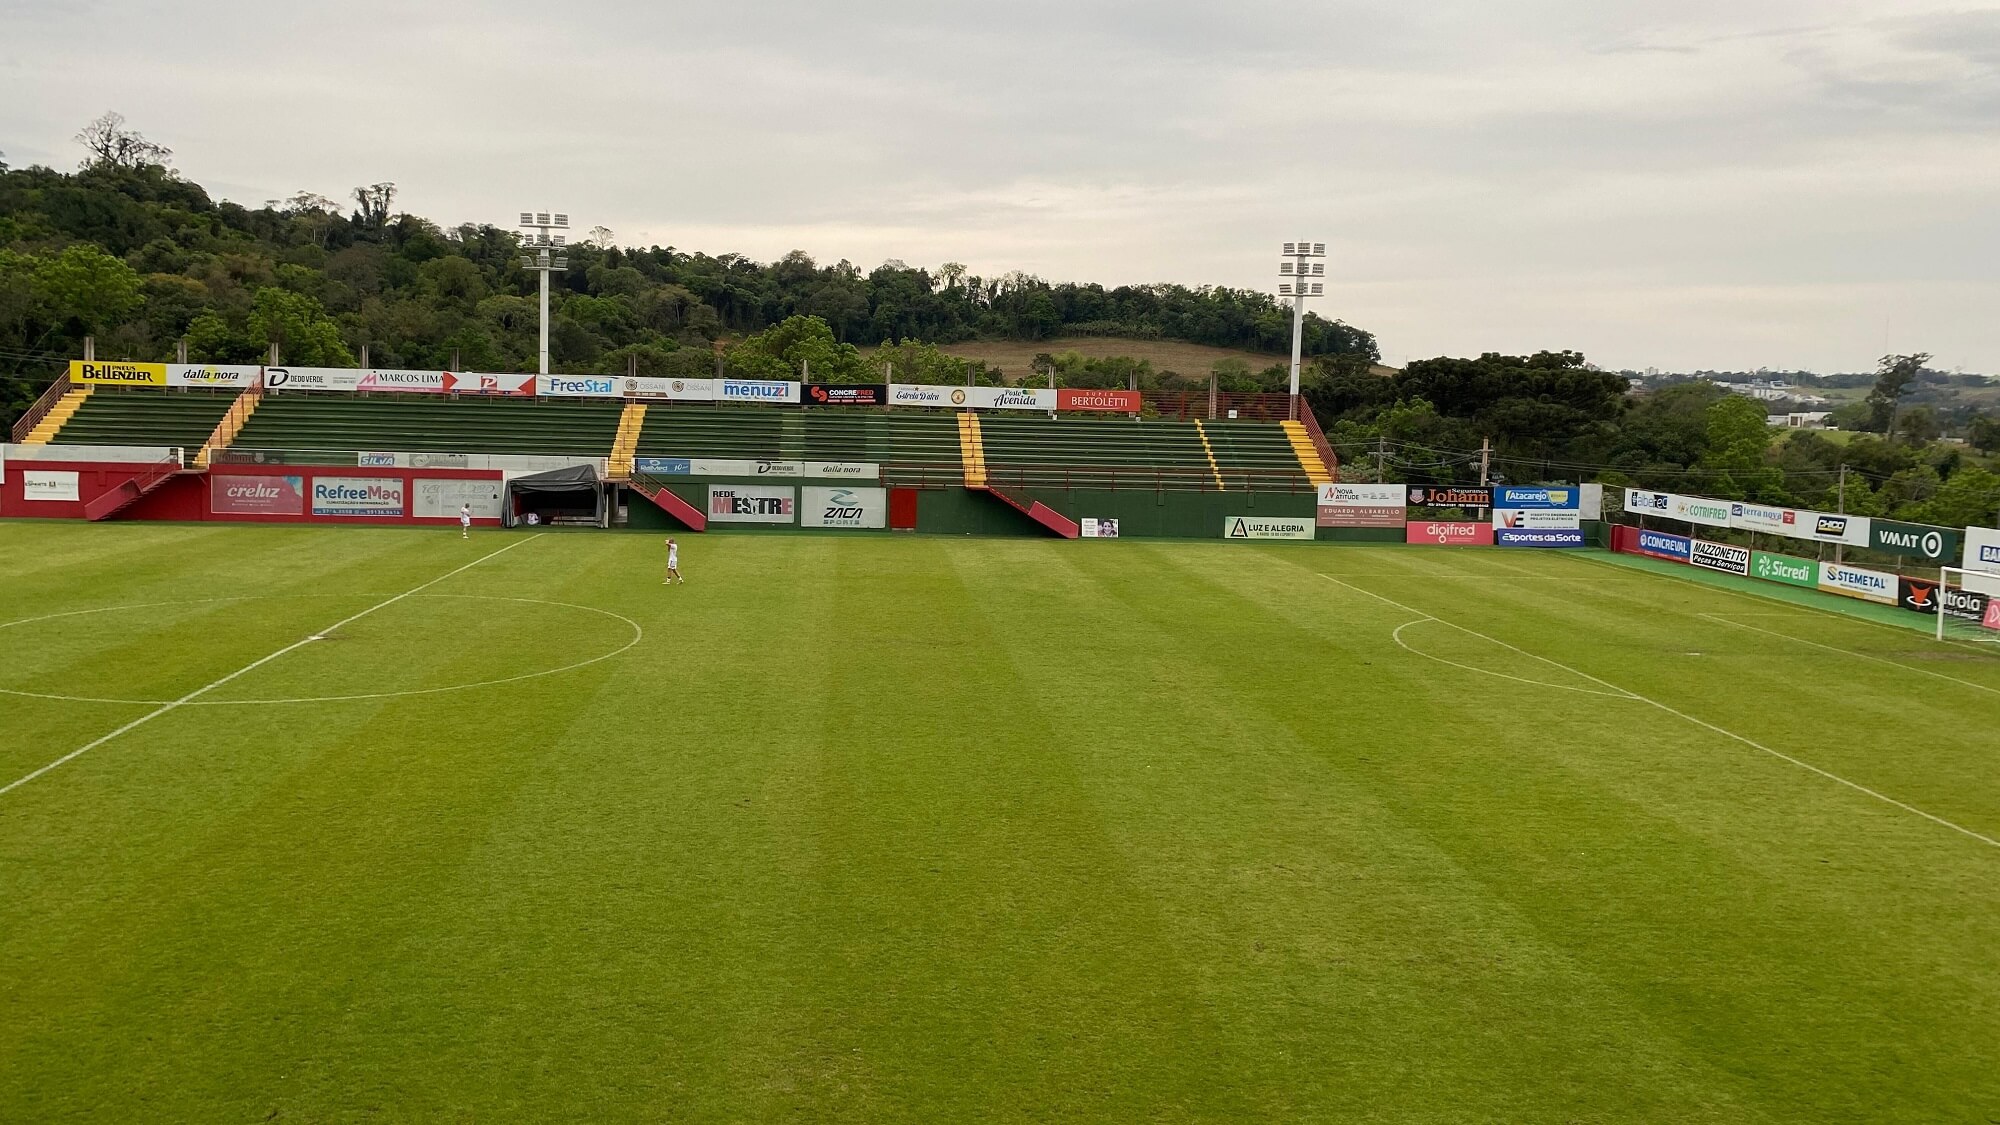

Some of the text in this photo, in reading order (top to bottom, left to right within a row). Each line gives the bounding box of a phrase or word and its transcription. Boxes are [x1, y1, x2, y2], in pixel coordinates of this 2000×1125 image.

[183, 369, 210, 379] dalla
[213, 371, 239, 380] nora
[305, 375, 323, 383] VERDE
[379, 373, 444, 383] MARCOS LIMA
[551, 379, 612, 393] FreeStal
[724, 383, 789, 397] menuzzi
[993, 394, 1037, 407] Avenida
[1071, 396, 1128, 407] BERTOLETTI
[361, 457, 394, 465] SILVA
[823, 465, 841, 473] dalla
[227, 484, 281, 498] creluz
[315, 484, 400, 504] RefreeMaq
[1427, 489, 1489, 503] Johann
[1509, 491, 1546, 500] Atacarejo
[712, 497, 792, 514] MESTRE
[1690, 504, 1727, 520] COTRIFRED
[1743, 506, 1762, 517] terra
[824, 507, 863, 519] ZACA
[1818, 519, 1844, 530] CHICO
[1427, 523, 1475, 543] digifred
[1502, 533, 1544, 542] Esportes
[1556, 534, 1581, 542] Sorte
[1879, 530, 1919, 548] VMAT
[1647, 535, 1687, 553] CONCREVAL
[1693, 542, 1747, 562] MAZZONETTO
[1694, 554, 1710, 566] Peças
[1716, 559, 1745, 572] Serviços
[1771, 560, 1809, 581] Sicredi
[1838, 570, 1885, 589] STEMETAL
